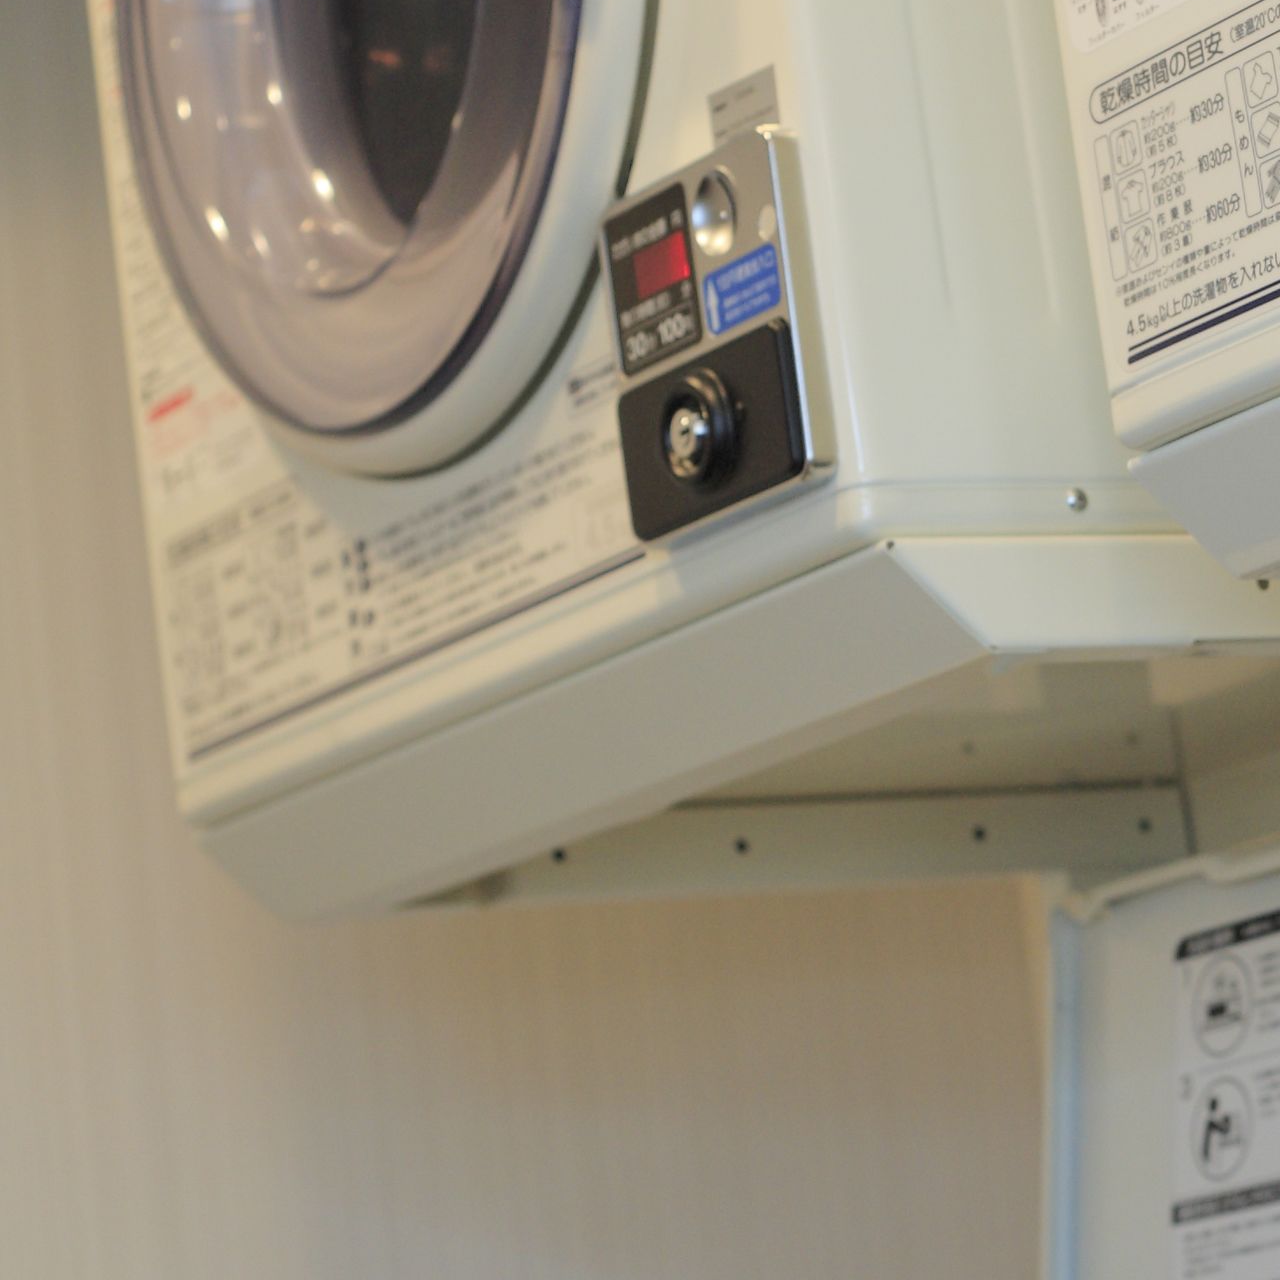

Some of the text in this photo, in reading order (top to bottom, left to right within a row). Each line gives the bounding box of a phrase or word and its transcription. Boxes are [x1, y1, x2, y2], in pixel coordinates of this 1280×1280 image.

[1098, 30, 1223, 115] 乾燥時間の目安
[1189, 91, 1225, 124] 約30分
[1148, 149, 1184, 178] ブラウス
[1197, 141, 1233, 174] 約30分
[1205, 192, 1241, 224] 約60分
